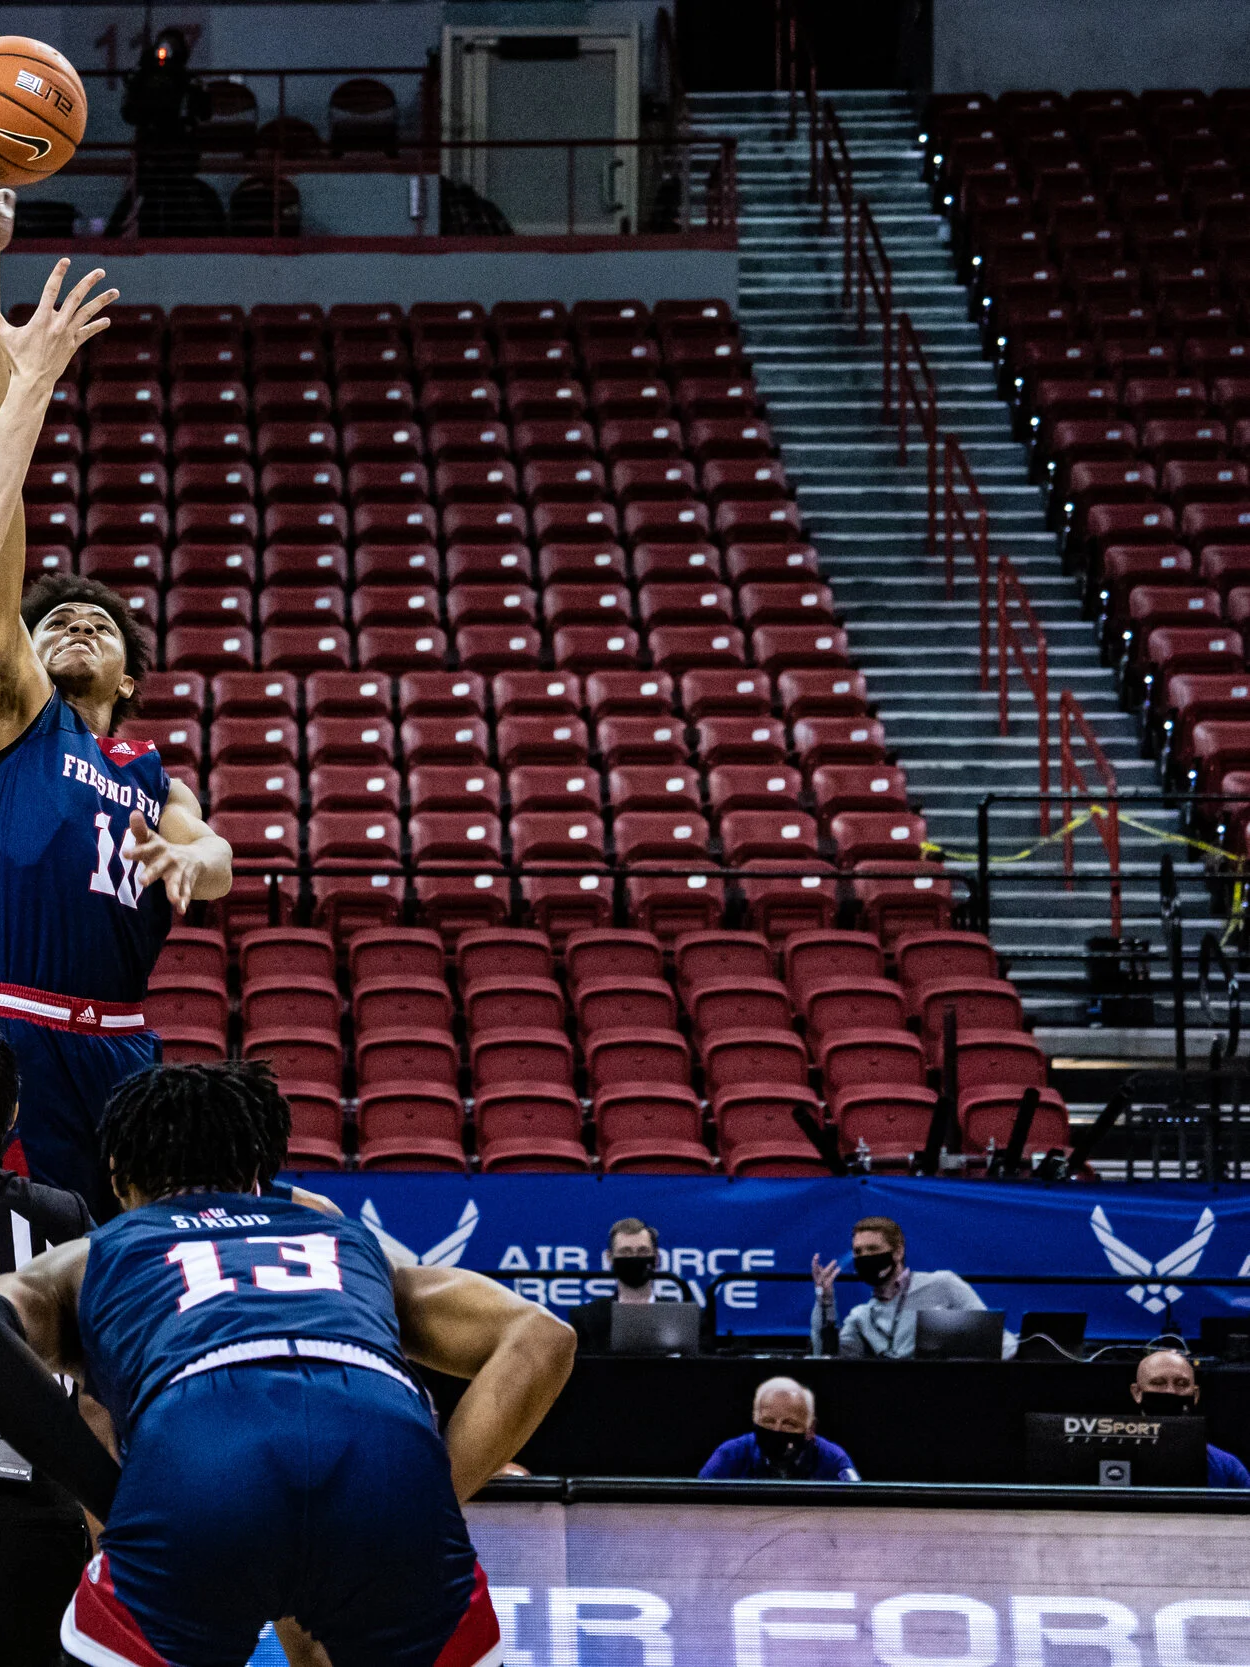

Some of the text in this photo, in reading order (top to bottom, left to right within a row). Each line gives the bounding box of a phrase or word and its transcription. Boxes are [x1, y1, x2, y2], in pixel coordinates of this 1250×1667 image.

[14, 69, 74, 118] ELITE
[62, 753, 161, 826] FRESNO STA
[170, 1213, 271, 1229] STROUD
[163, 1232, 343, 1317] 13
[498, 1245, 589, 1271] AIR
[487, 1586, 1250, 1667] IR FORC
